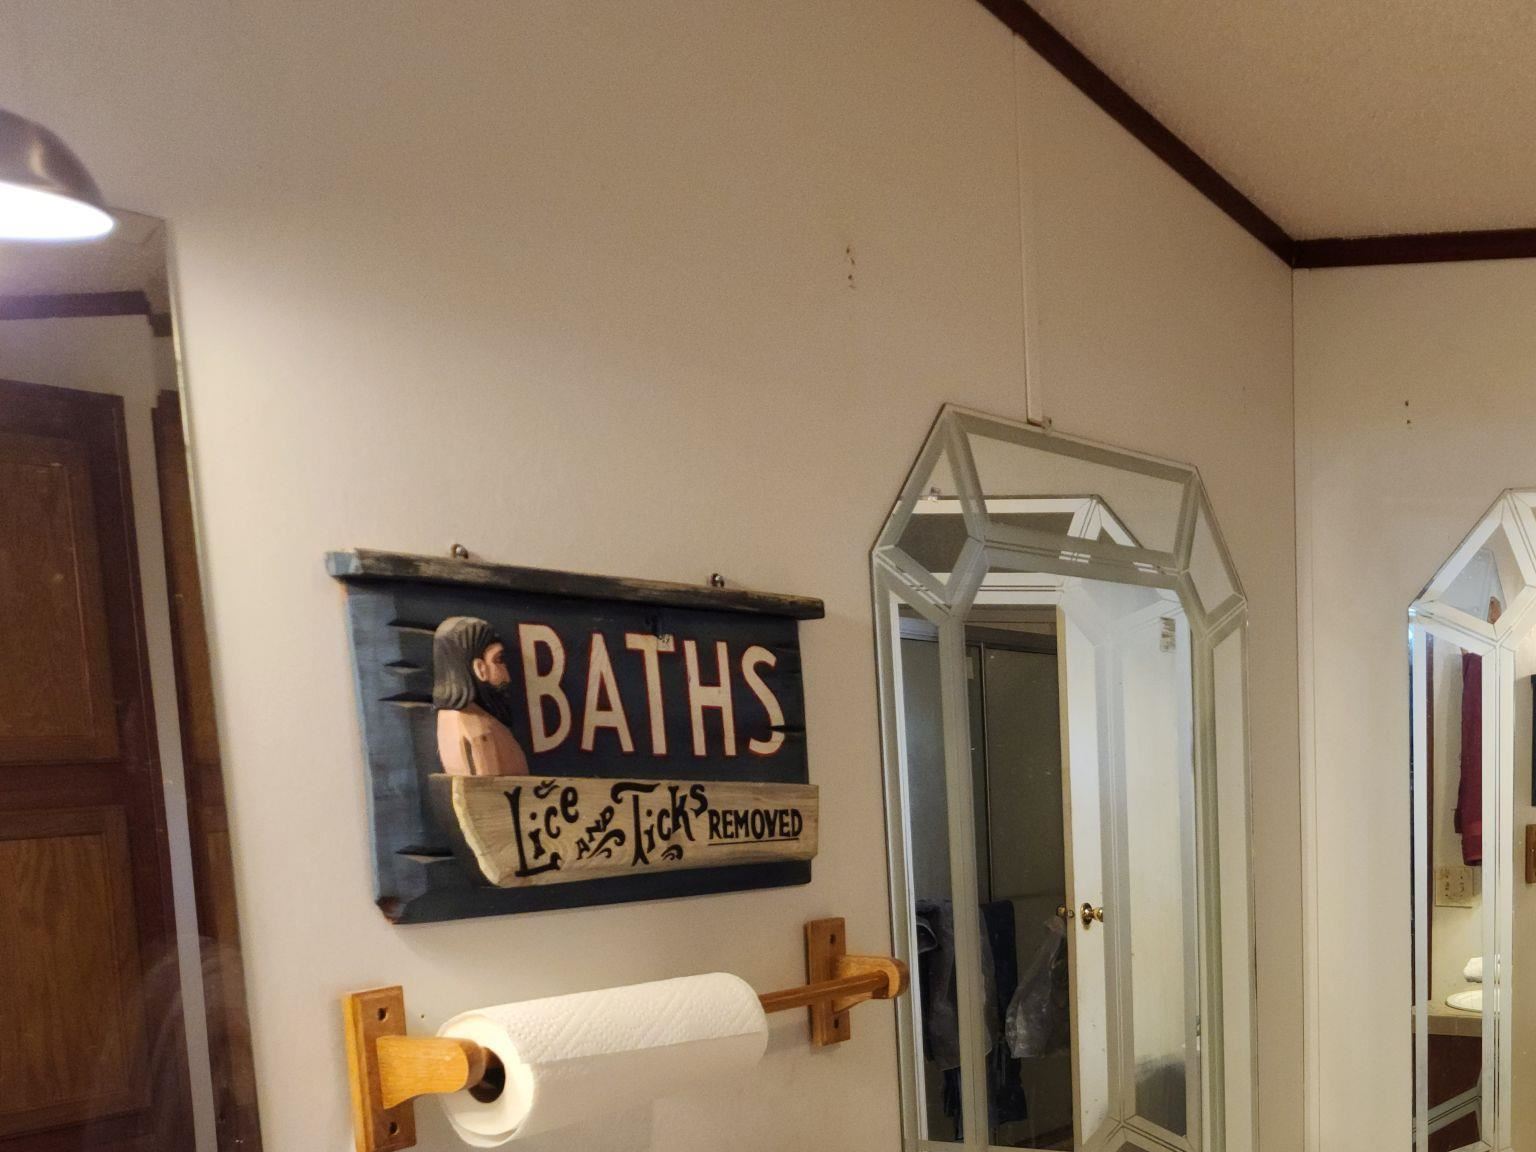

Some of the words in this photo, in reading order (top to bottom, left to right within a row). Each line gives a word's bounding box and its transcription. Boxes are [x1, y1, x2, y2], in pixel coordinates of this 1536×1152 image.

[517, 622, 786, 757] BATHS
[504, 785, 580, 876] Lice
[611, 783, 709, 866] Ticks
[708, 808, 803, 840] REMOVED
